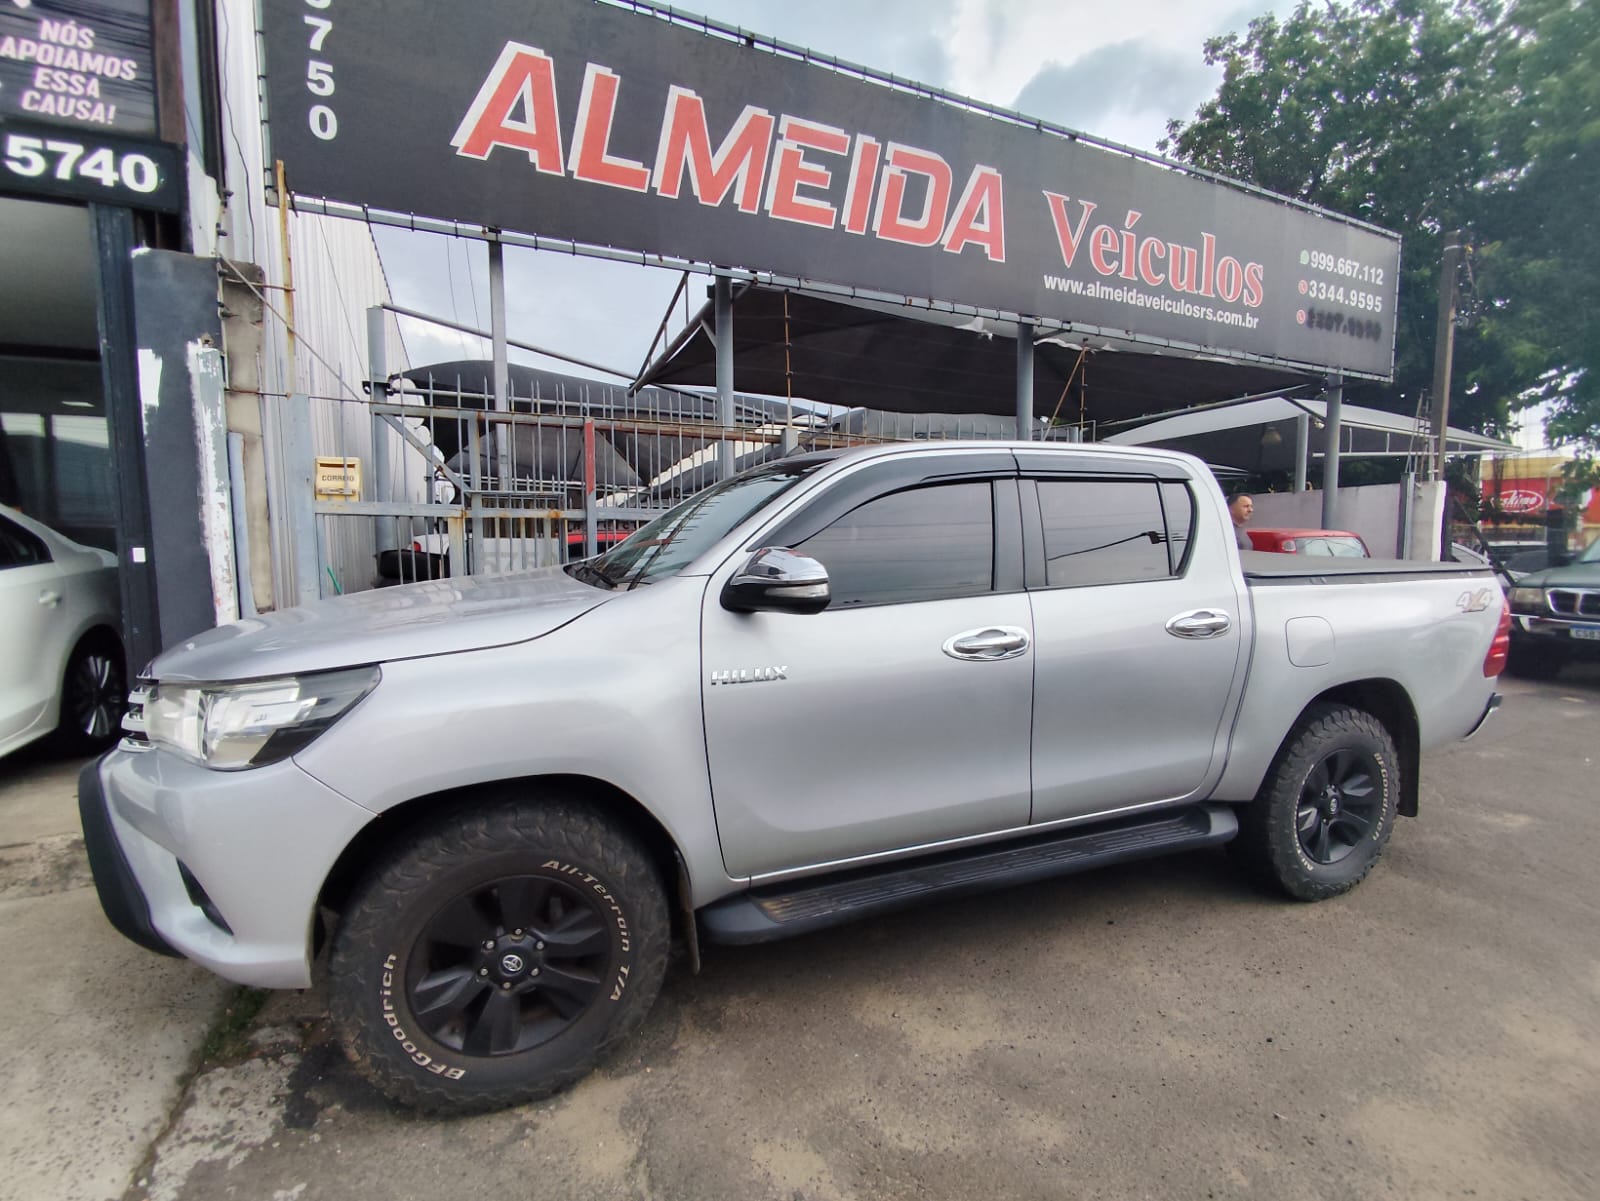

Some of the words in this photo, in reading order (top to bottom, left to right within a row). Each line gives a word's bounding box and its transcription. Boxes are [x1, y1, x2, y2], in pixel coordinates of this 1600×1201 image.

[40, 19, 95, 49] NÓS
[0, 36, 138, 80] APOIAMOS
[303, 0, 338, 140] 750
[34, 66, 100, 98] ESSA
[21, 90, 117, 125] CAUSA!
[5, 134, 159, 193] 5740
[450, 40, 1005, 262] ALMEIDA
[1042, 190, 1264, 307] Veículos
[1310, 250, 1384, 285] 999.667.112
[1044, 275, 1259, 329] www.almeidaveiculosrs.com.br
[1308, 280, 1382, 312] 3344.9595
[711, 665, 788, 685] HILUX
[541, 859, 631, 952] All-Terrain
[609, 964, 631, 1001] T/A
[379, 954, 467, 1080] BFGoodrich
